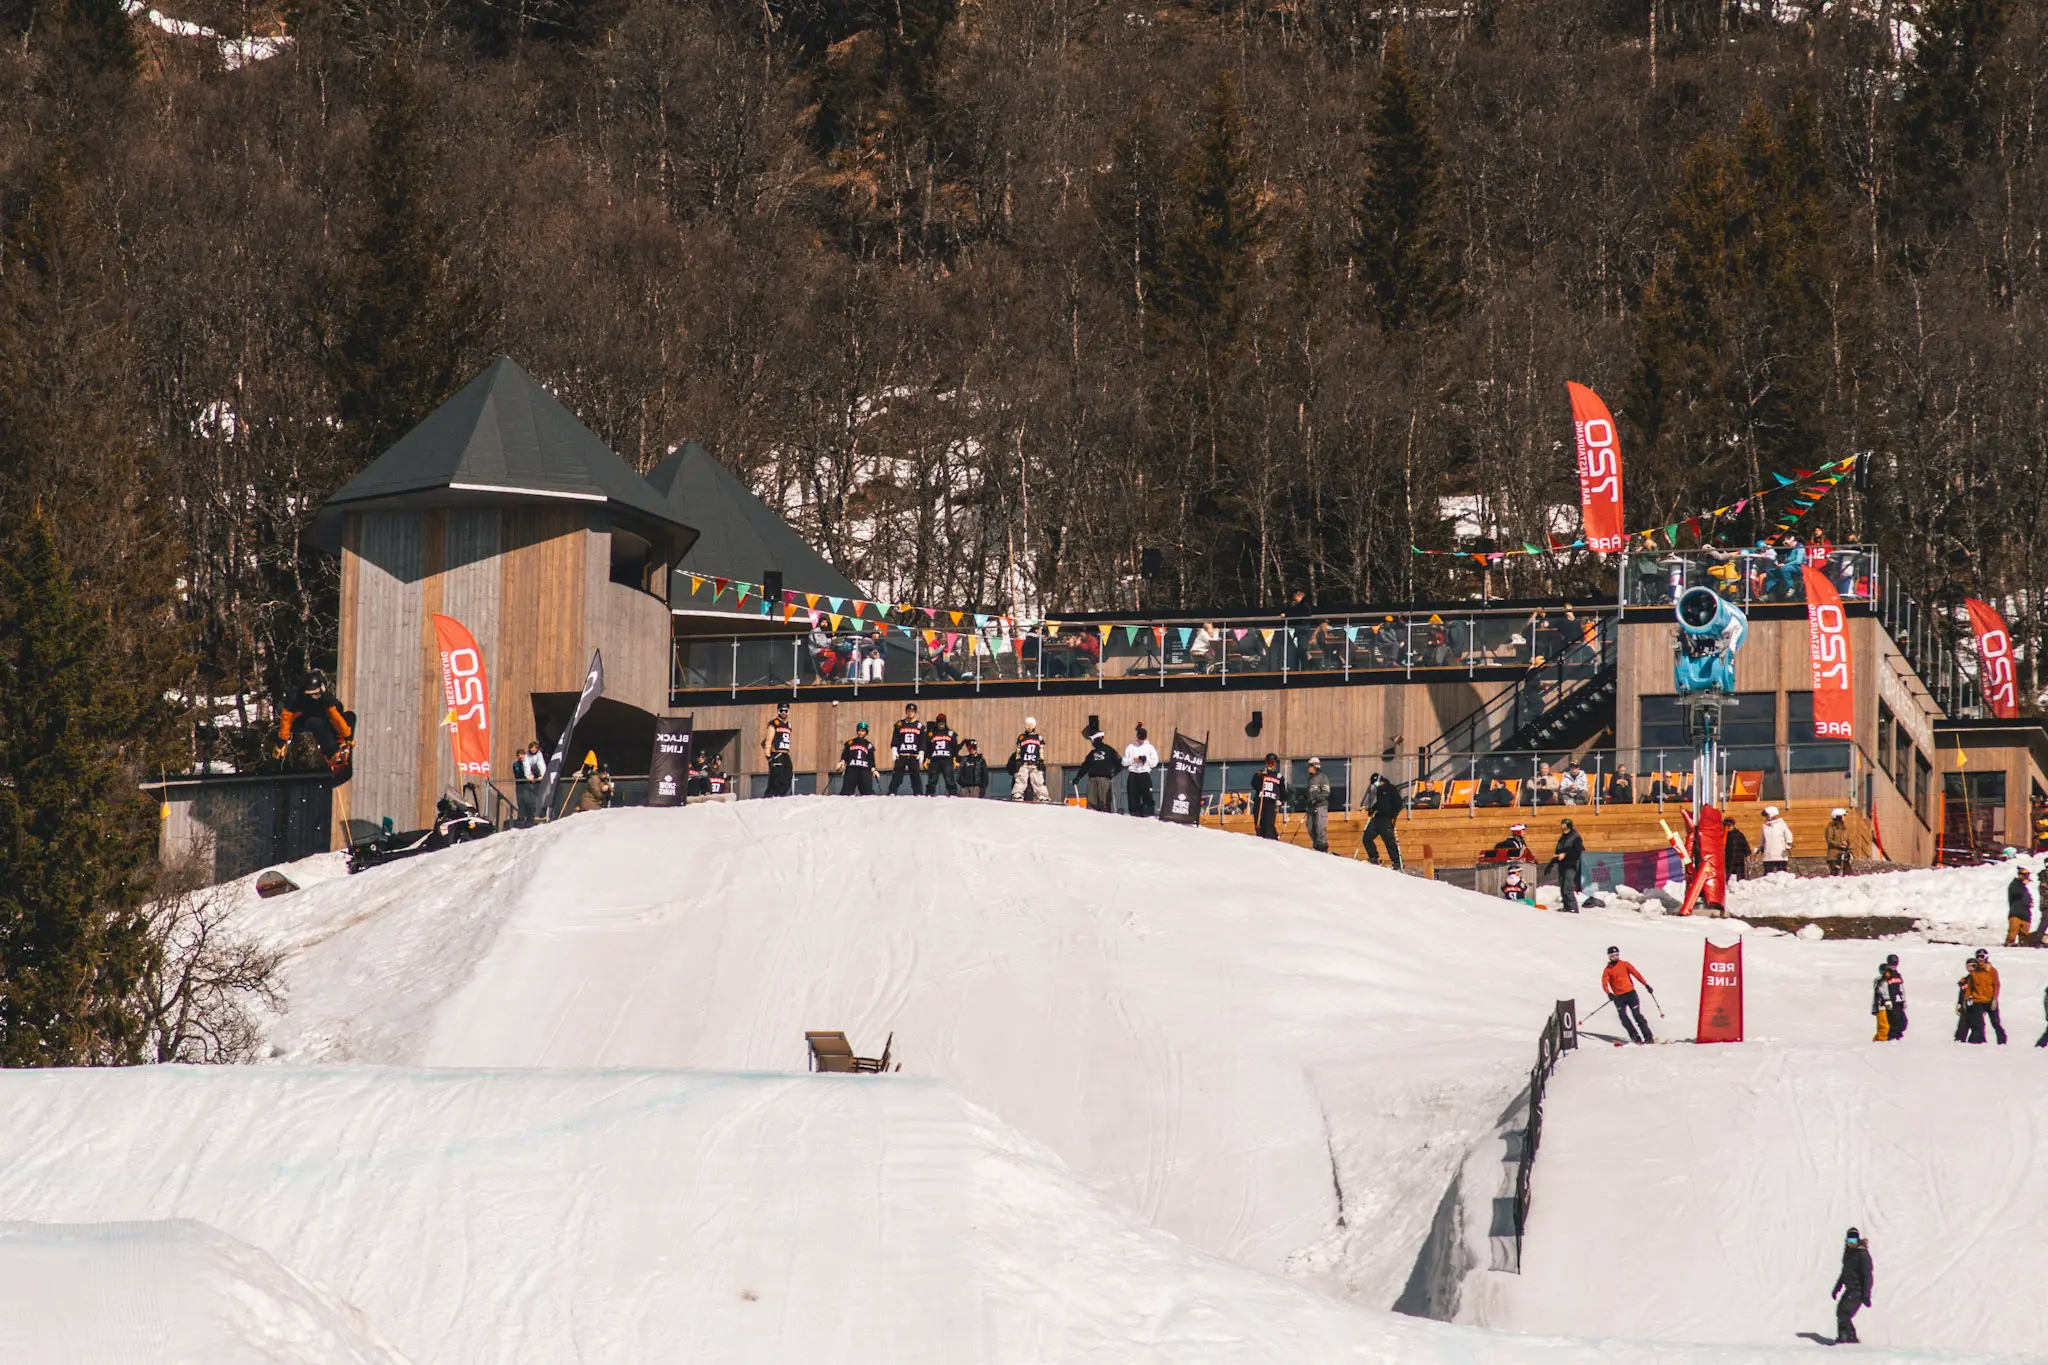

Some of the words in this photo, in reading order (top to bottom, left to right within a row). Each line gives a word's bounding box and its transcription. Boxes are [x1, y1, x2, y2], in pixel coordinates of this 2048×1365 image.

[1812, 548, 1825, 560] 12
[935, 740, 946, 749] 29
[857, 750, 862, 759] 1
